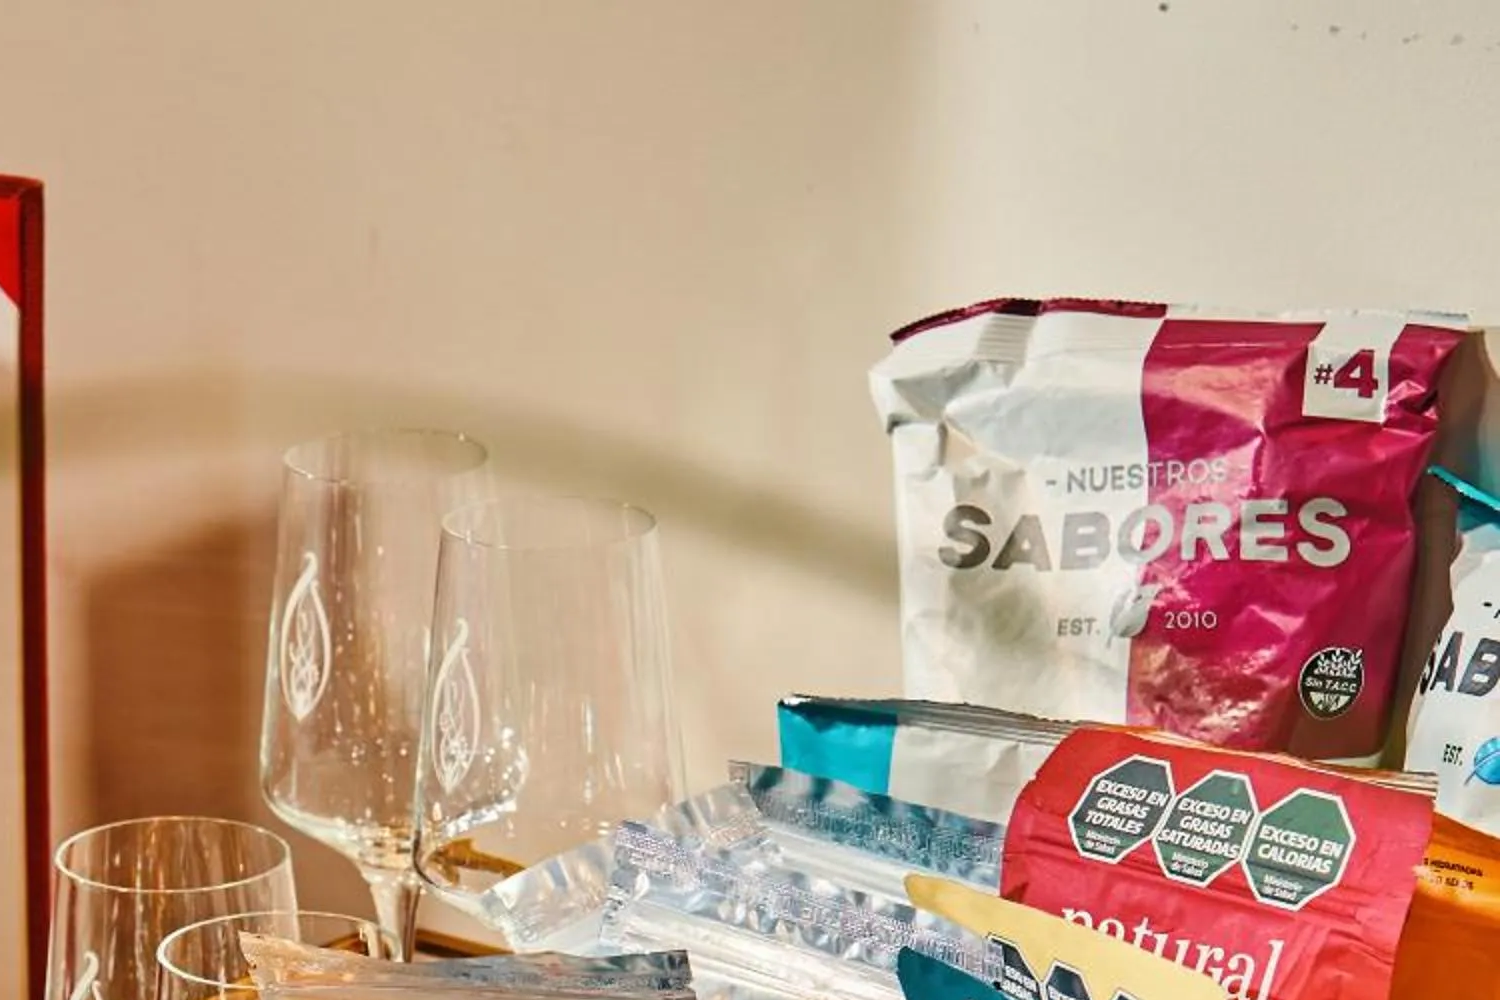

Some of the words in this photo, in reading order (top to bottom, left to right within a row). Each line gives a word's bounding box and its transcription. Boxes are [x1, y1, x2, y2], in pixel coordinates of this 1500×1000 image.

[1313, 348, 1379, 399] #4
[1066, 458, 1230, 493] NUESTROS
[937, 497, 1351, 571] SABORES
[1057, 618, 1101, 637] EST.
[1164, 611, 1218, 630] 2010
[1095, 779, 1147, 802] EXCESO
[1149, 791, 1169, 807] EN
[1097, 797, 1150, 819] GRASAS
[1178, 797, 1230, 820] EXCESO
[1231, 809, 1252, 825] EN
[1085, 810, 1145, 835] TOTALES
[1180, 815, 1234, 839] GRASAS
[1157, 828, 1241, 859] SATURADAS
[1260, 824, 1319, 852] EXCESO
[1320, 839, 1344, 859] EN
